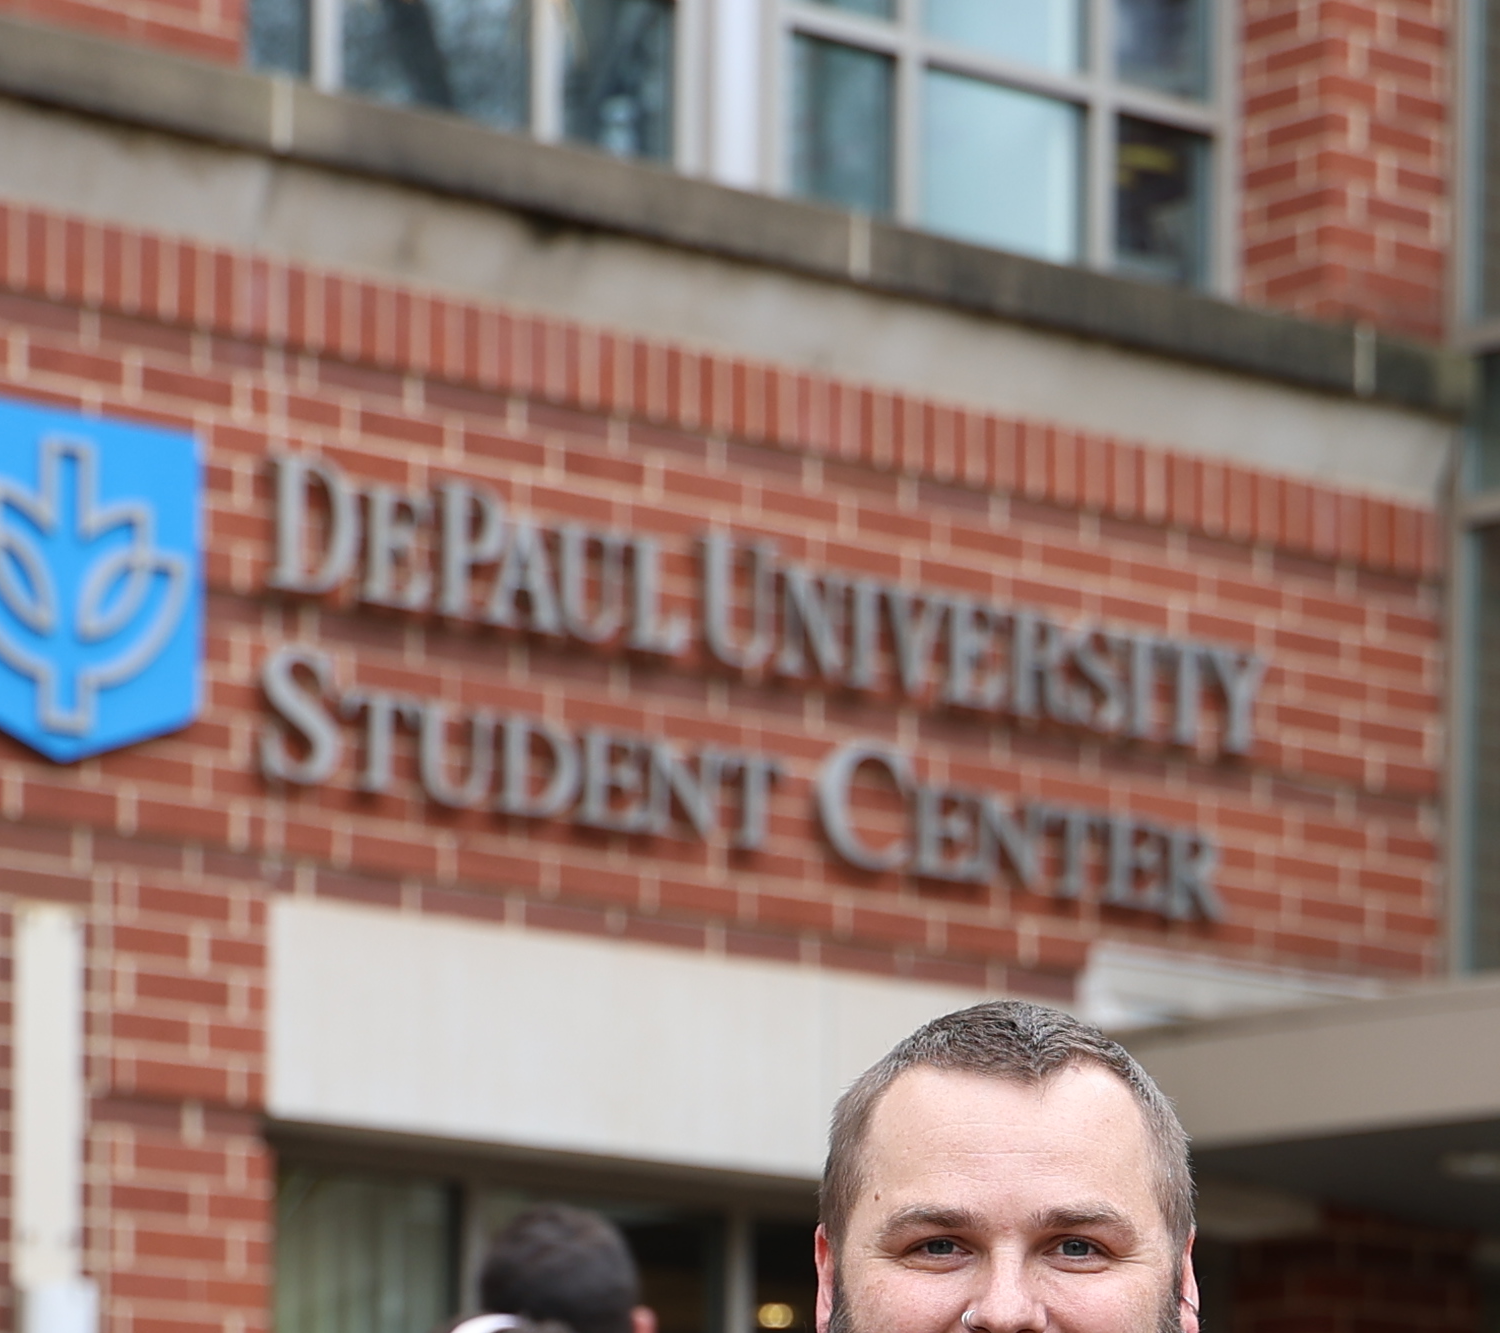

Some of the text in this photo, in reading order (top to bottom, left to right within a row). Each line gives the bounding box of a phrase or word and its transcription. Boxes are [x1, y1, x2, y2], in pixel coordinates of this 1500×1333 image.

[699, 526, 1268, 760] UNIVERSITY
[257, 643, 1226, 926] STUDENT CENTER
